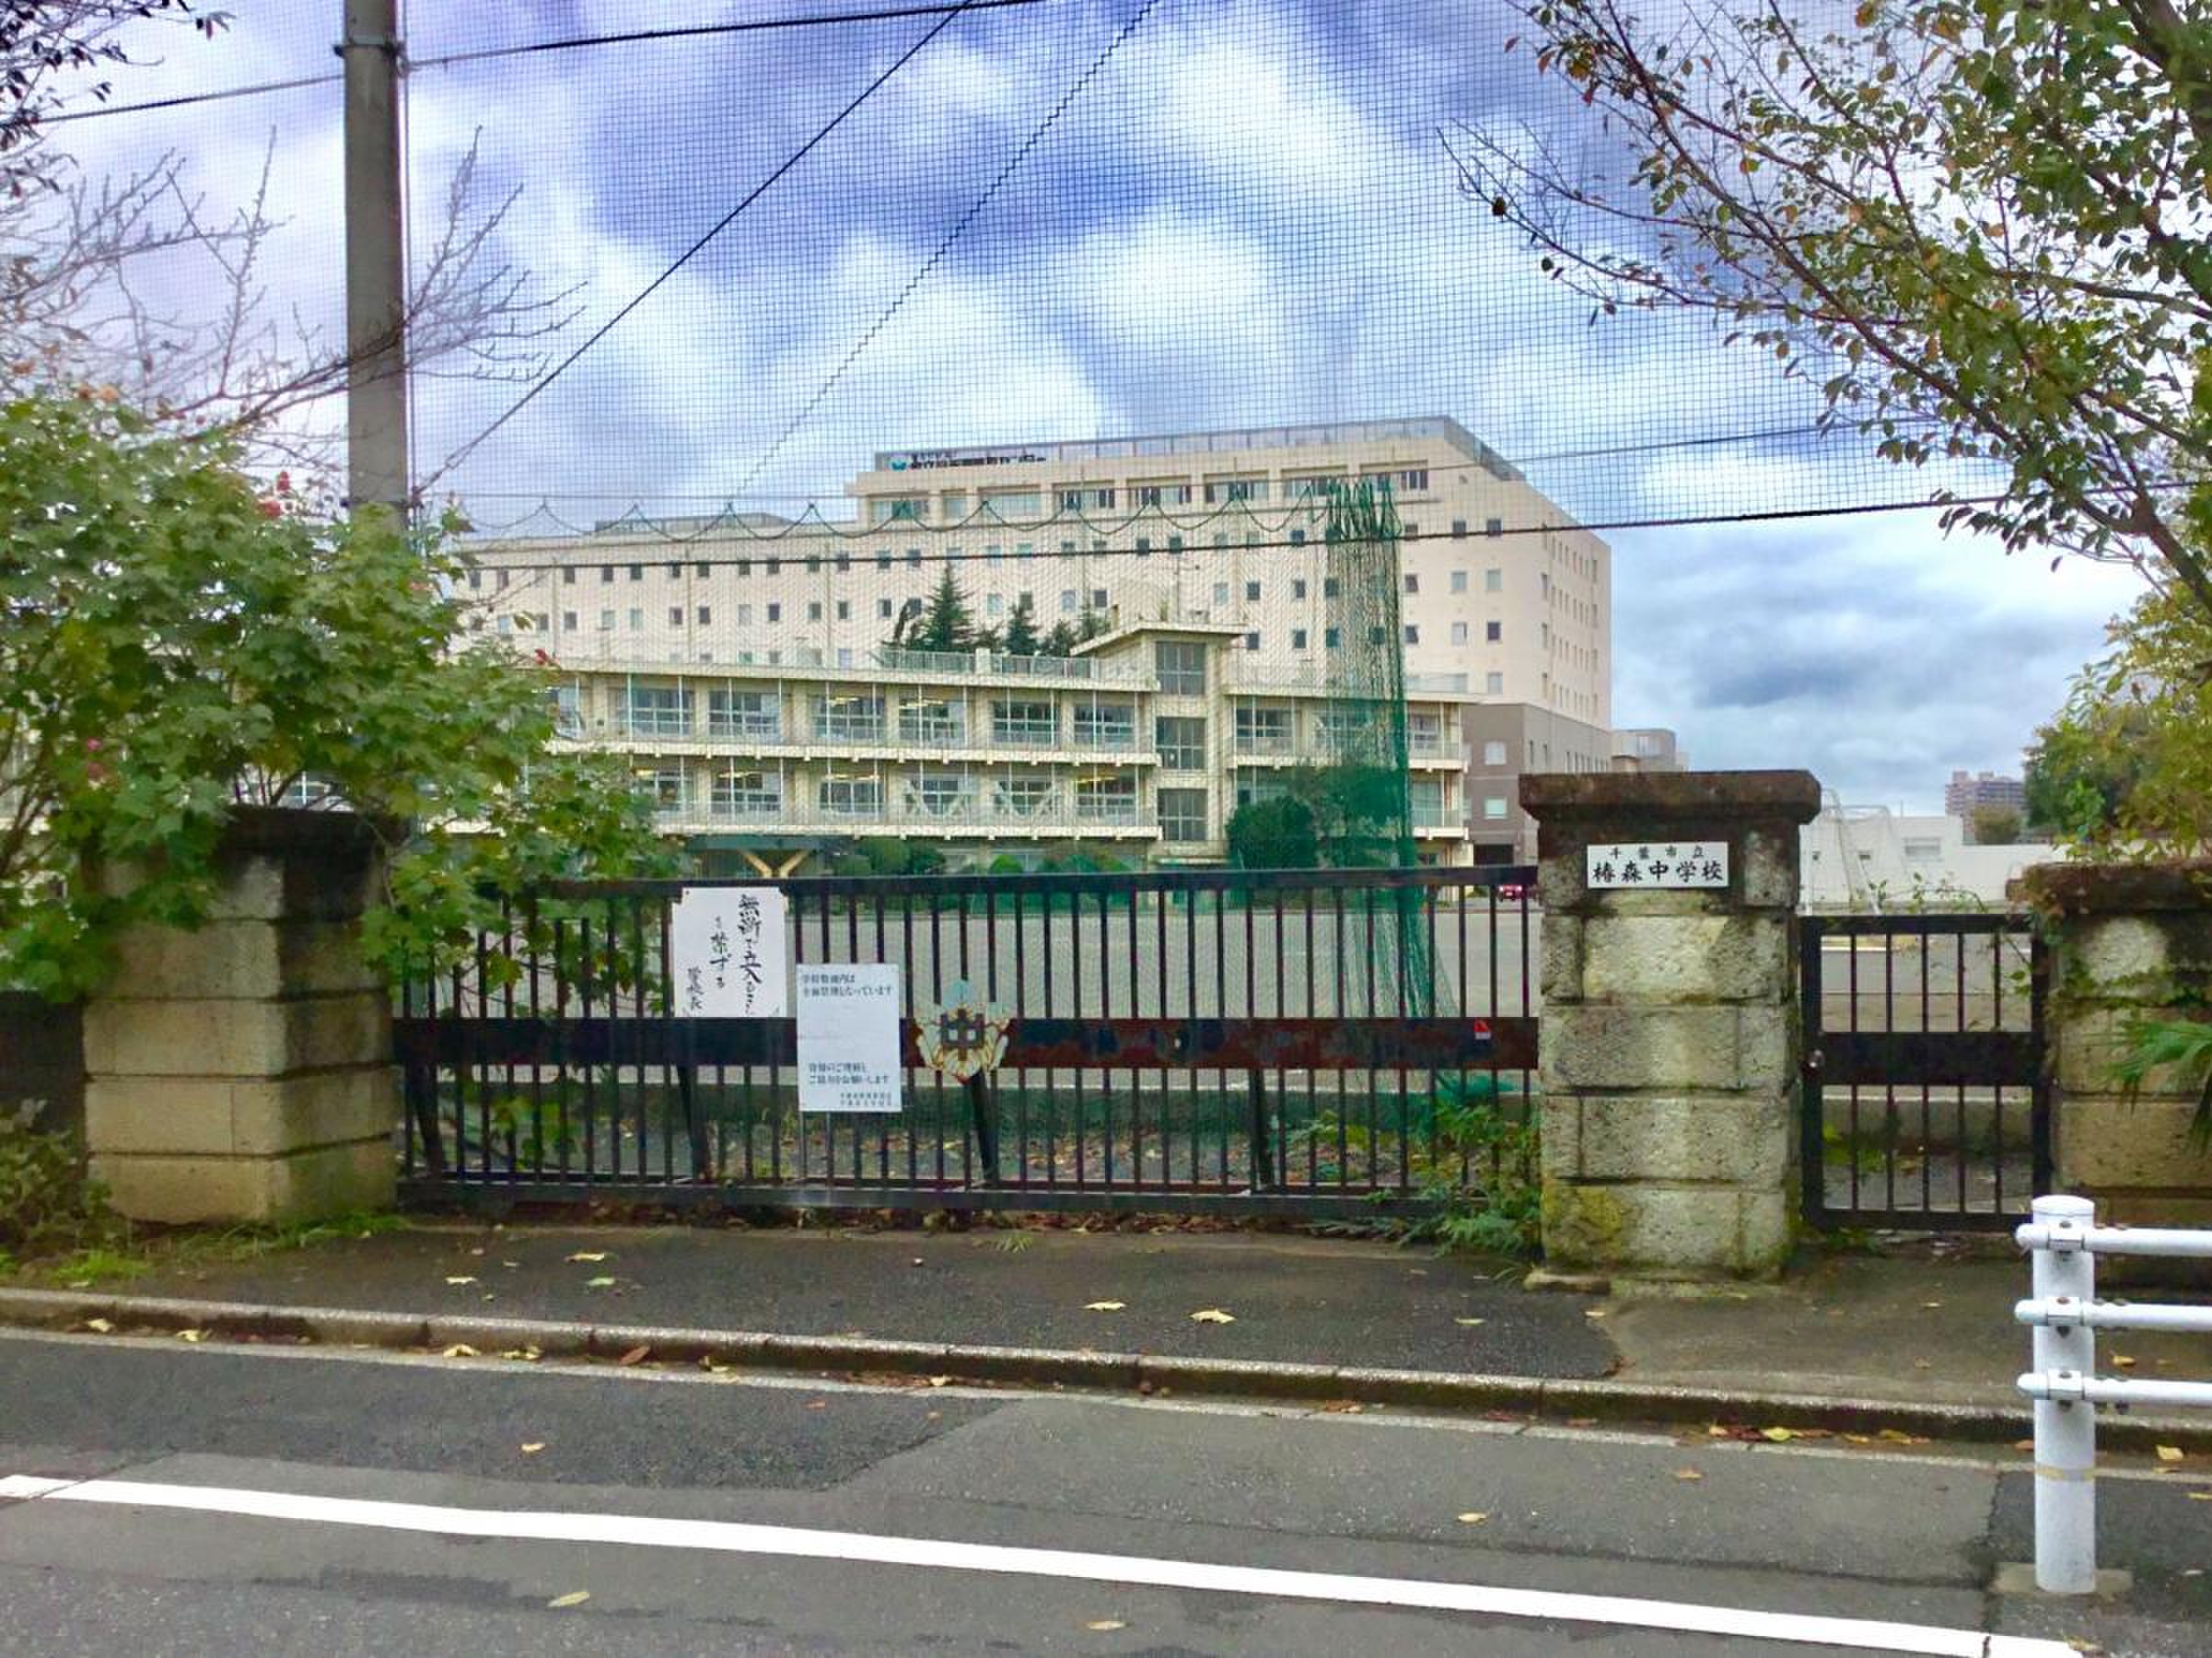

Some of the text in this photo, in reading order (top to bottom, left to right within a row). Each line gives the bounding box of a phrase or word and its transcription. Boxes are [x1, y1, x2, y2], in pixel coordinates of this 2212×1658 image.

[1592, 859, 1724, 882] 椿森中学校
